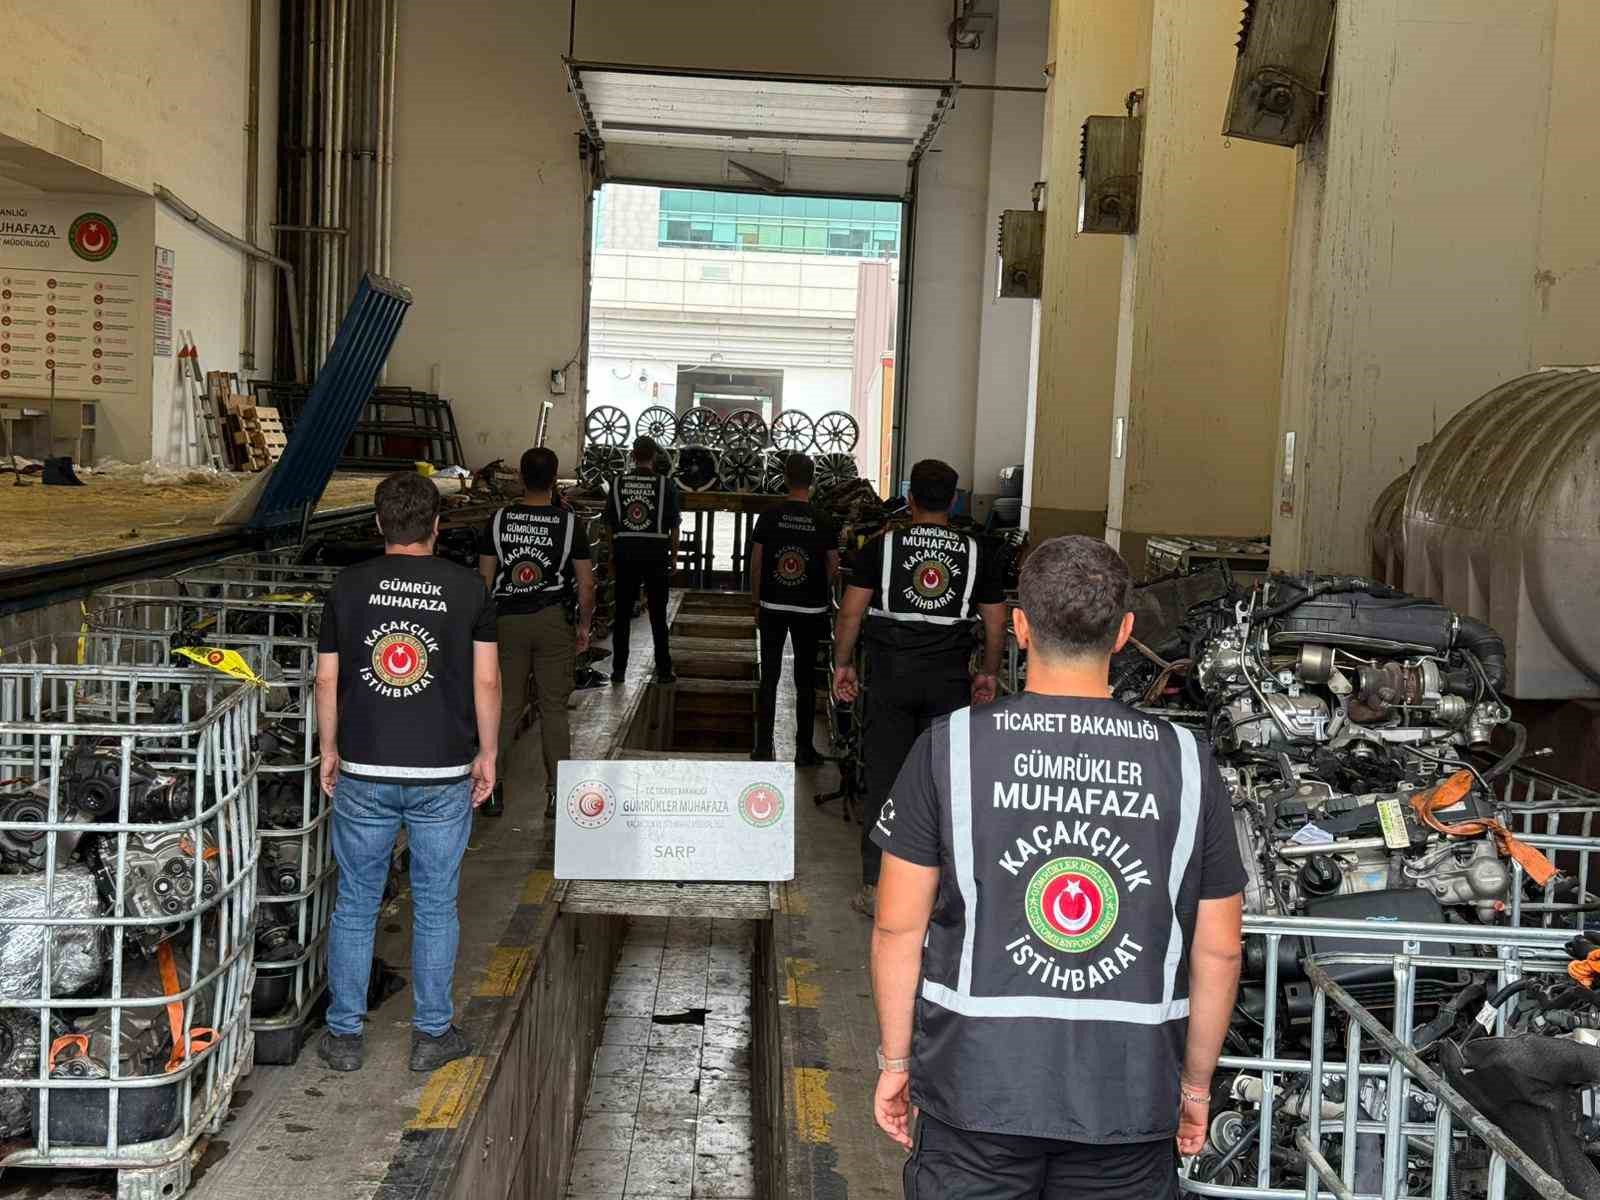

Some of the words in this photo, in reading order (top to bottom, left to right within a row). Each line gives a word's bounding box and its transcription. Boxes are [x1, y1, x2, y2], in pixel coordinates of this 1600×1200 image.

[501, 533, 553, 547] MUHAFAZA
[506, 523, 549, 536] GÜMRÜKLER
[910, 526, 960, 541] GÜMRÜKLER
[902, 535, 967, 553] MUHAFAZA
[504, 546, 552, 568] KAÇAKÇILIK
[902, 549, 962, 577] KAÇAKÇILIK
[379, 577, 443, 596] GÜMRÜK
[902, 586, 957, 610] İSTİHBARAT
[368, 593, 448, 613] MUHAFAZA
[363, 620, 440, 653] KAÇAKÇILIK
[359, 666, 435, 698] İSTİHBARAT
[993, 709, 1066, 733] TİCARET
[1070, 713, 1159, 741] BAKANLIĞI
[1014, 749, 1143, 786] GÜMRÜKLER
[992, 781, 1160, 821] MUHAFAZA
[654, 845, 697, 859] SARP
[998, 820, 1152, 893] KAÇAKÇILIK
[1005, 933, 1144, 993] İSTİHBARAT
